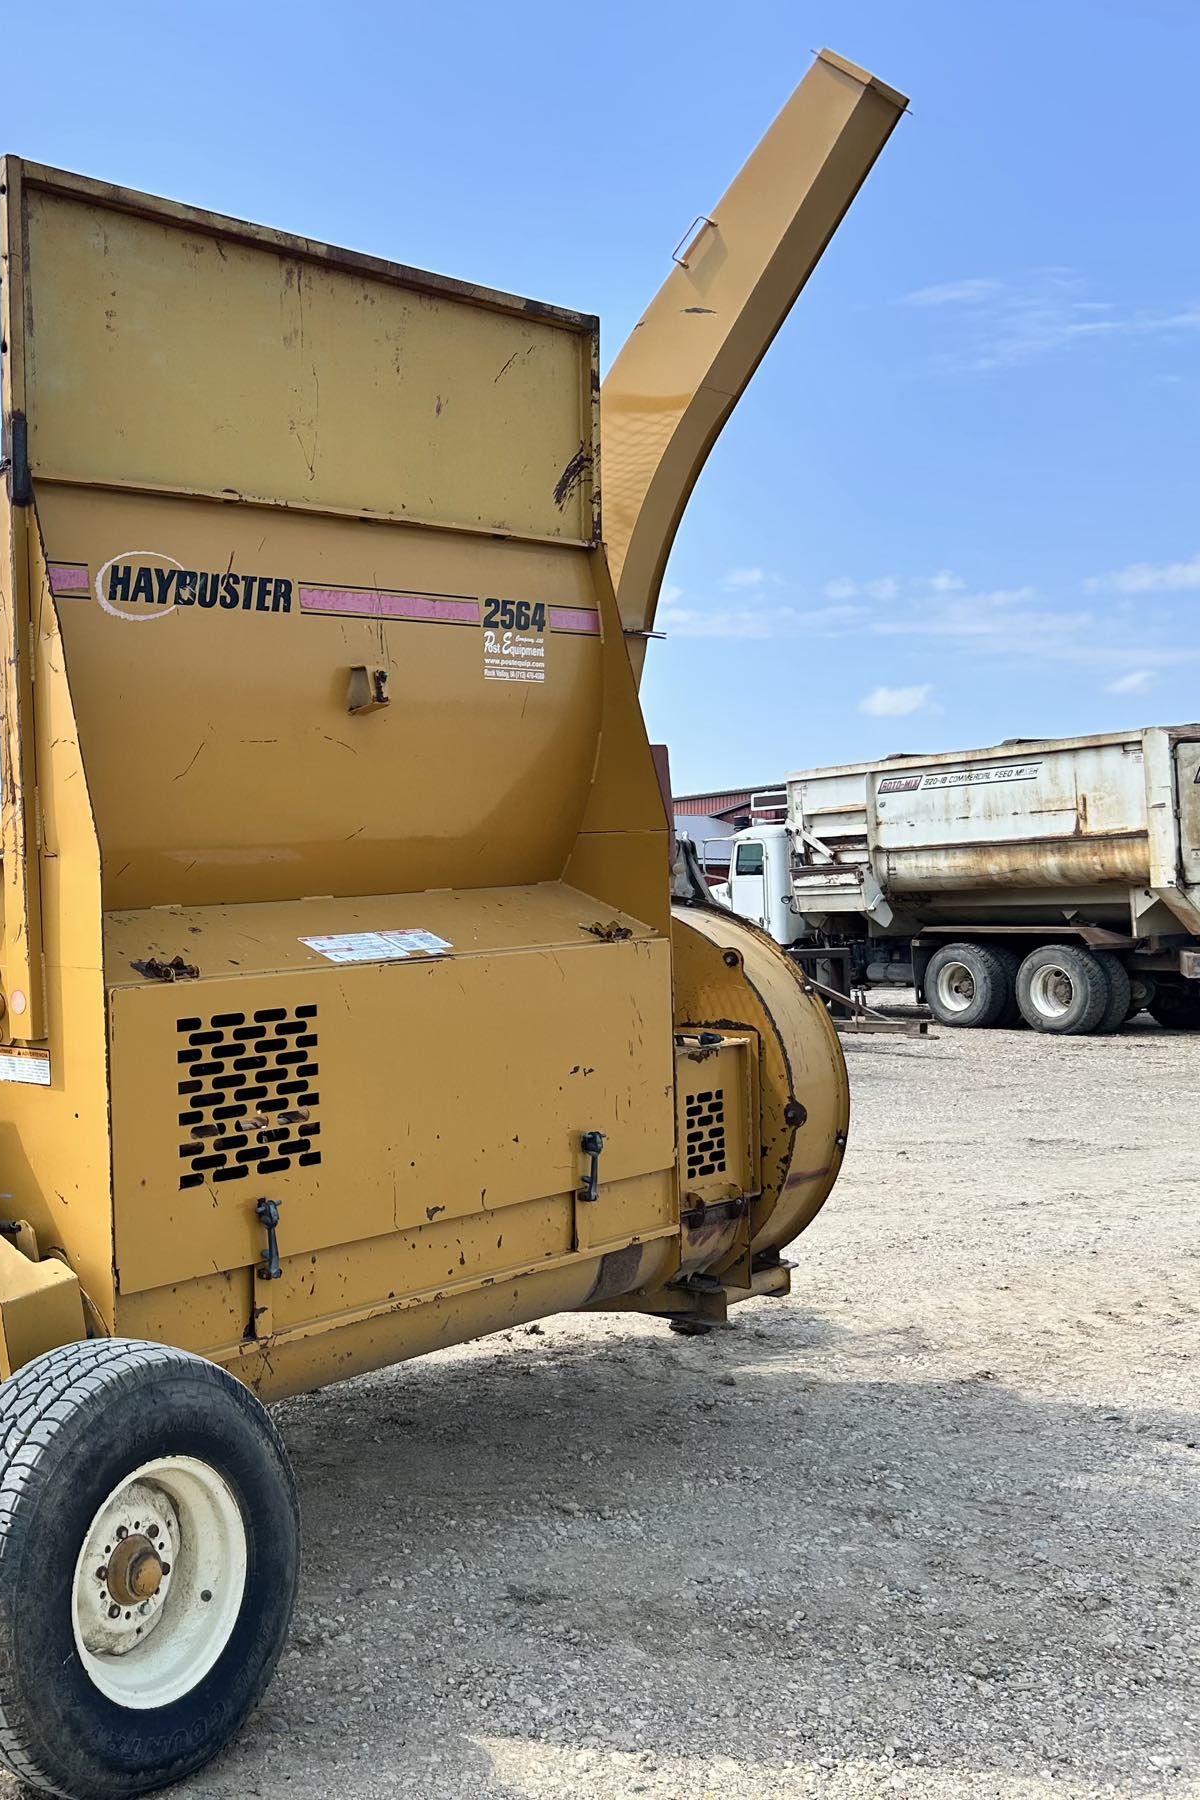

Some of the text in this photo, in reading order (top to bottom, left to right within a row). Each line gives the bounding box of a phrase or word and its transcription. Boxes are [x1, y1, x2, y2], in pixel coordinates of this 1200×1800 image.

[108, 564, 293, 612] HAYBUSTER
[483, 598, 546, 632] 2564
[483, 631, 544, 658] Post Equipment
[484, 657, 544, 669] www.postequip.com
[881, 779, 920, 790] ROTO-MIX
[948, 771, 991, 784] COMMERCIAL
[994, 769, 1014, 778] FEED
